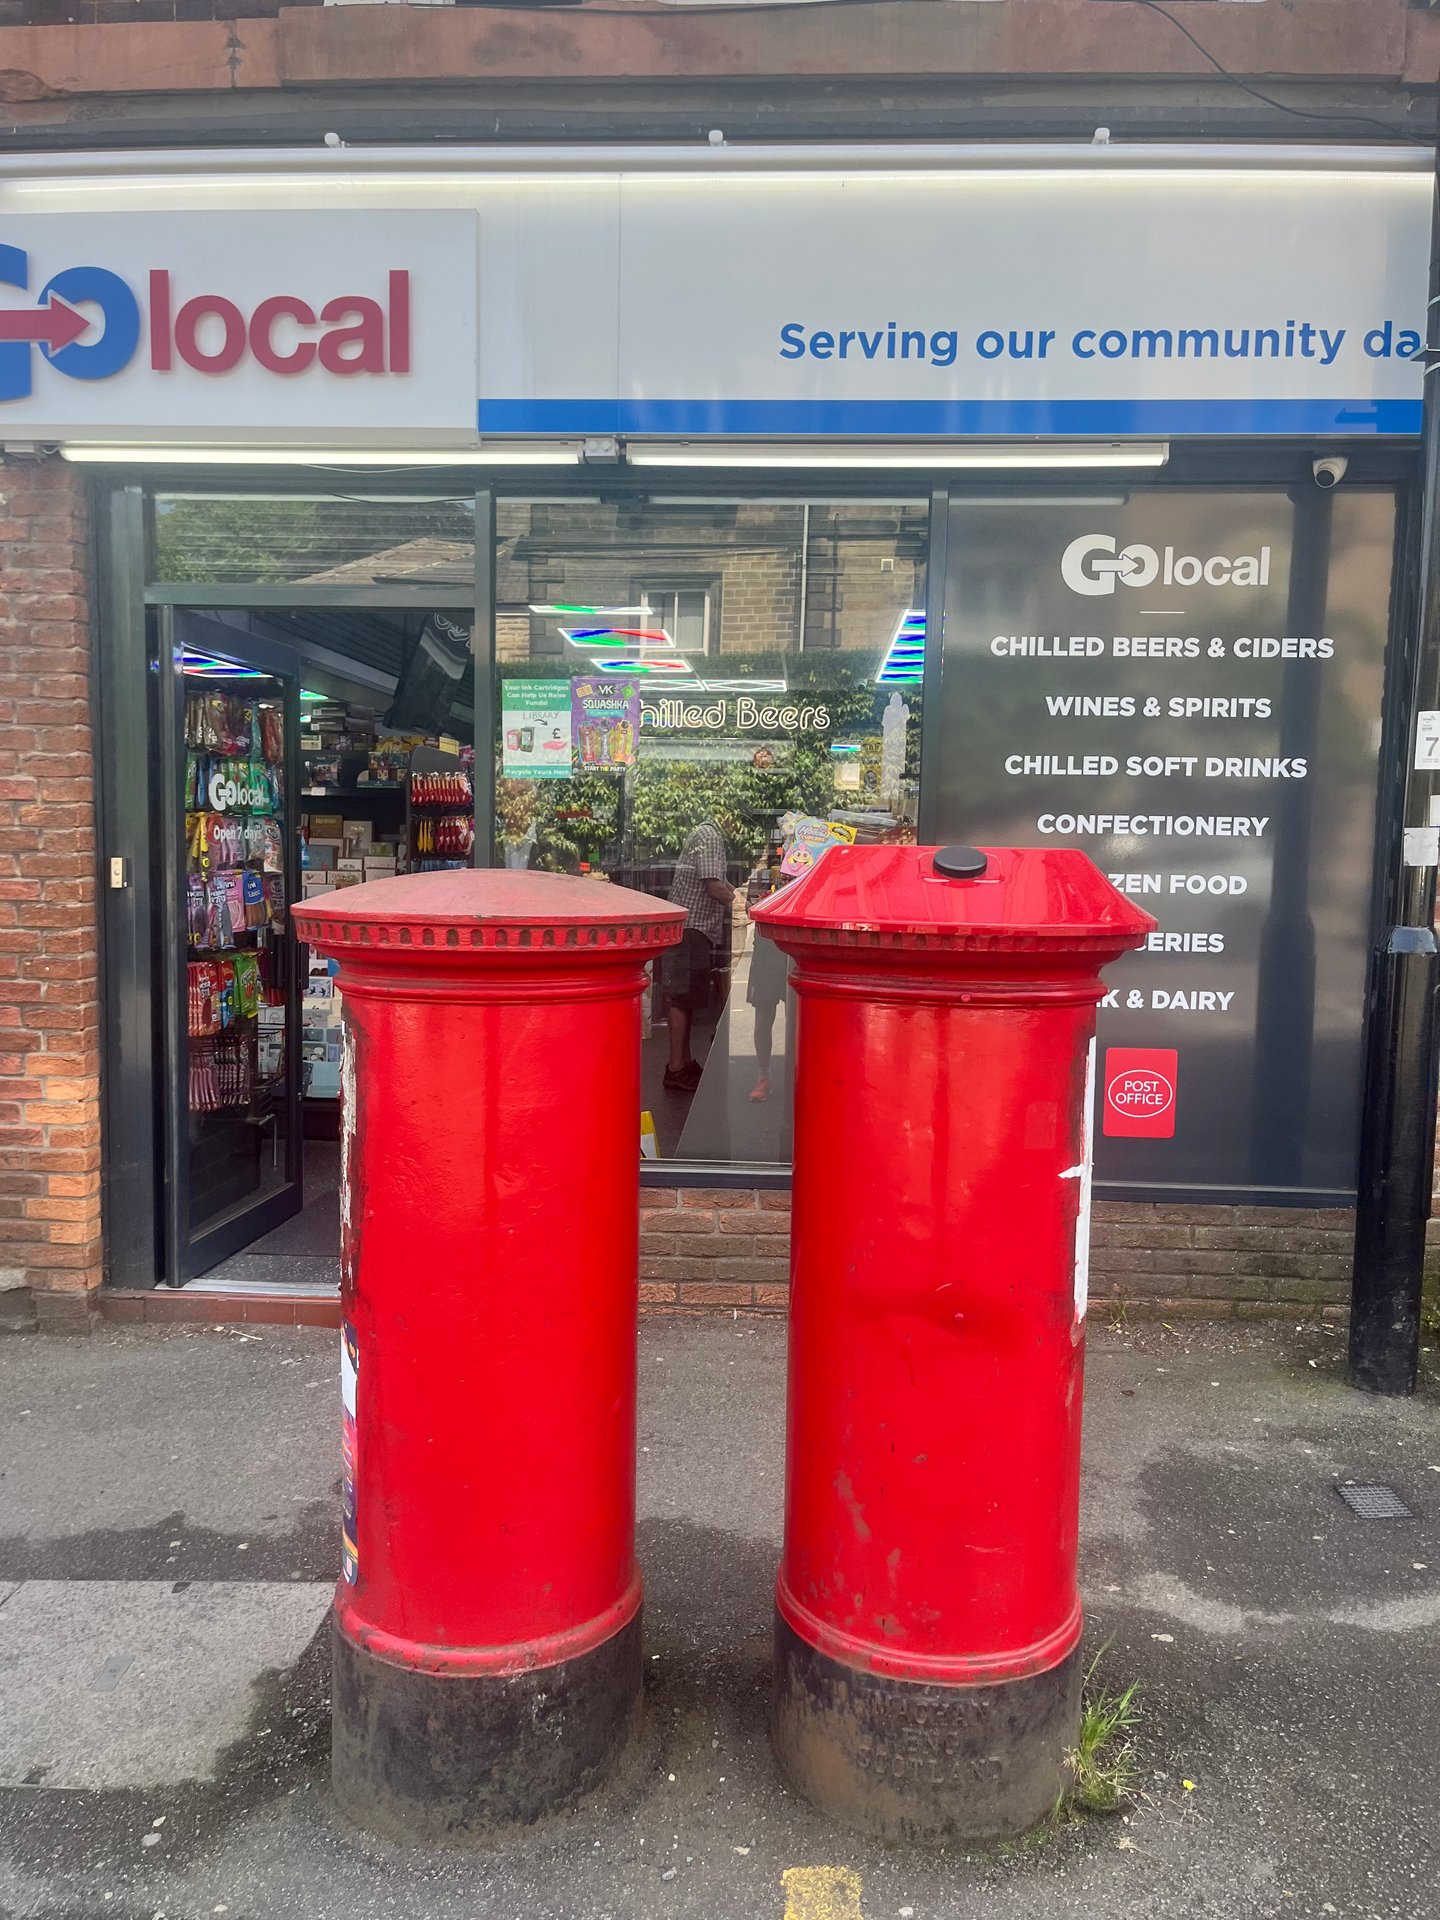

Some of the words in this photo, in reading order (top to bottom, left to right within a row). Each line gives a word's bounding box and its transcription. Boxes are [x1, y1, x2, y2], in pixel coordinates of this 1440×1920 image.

[0, 243, 140, 401] o
[149, 269, 410, 375] local
[779, 322, 958, 367] Serving
[975, 328, 1056, 360] our
[1071, 320, 1346, 365] community
[1363, 320, 1421, 359] da
[1163, 546, 1271, 586] local
[990, 636, 1105, 658] CHILLED
[1112, 637, 1200, 658] BEERS
[1207, 637, 1226, 658] &
[1233, 638, 1335, 659] CIDERS
[504, 684, 521, 692] Your
[598, 684, 614, 695] VK
[522, 711, 560, 720] LIBRARY
[582, 699, 629, 710] SQUASHKA
[638, 698, 727, 729] hilled
[736, 696, 831, 730] Beers
[1045, 696, 1136, 717] WINES
[1143, 697, 1162, 717] &
[1168, 697, 1272, 718] SPIRITS
[1004, 755, 1118, 777] CHILLED
[1125, 756, 1198, 777] SOFT
[1205, 757, 1308, 779] DRINKS
[237, 784, 265, 806] local
[213, 825, 237, 842] Open
[237, 826, 243, 839] 7
[244, 825, 263, 842] days
[1036, 813, 1270, 837] CONFECTIONERY
[1107, 873, 1161, 894] ZEN
[1169, 874, 1248, 895] FOOD
[1134, 932, 1225, 953] ERIES
[1096, 989, 1120, 1008] K
[1126, 990, 1145, 1009] &
[1151, 990, 1235, 1011] DAIRY
[1124, 1080, 1160, 1093] POST
[1115, 1092, 1164, 1106] OFFICE
